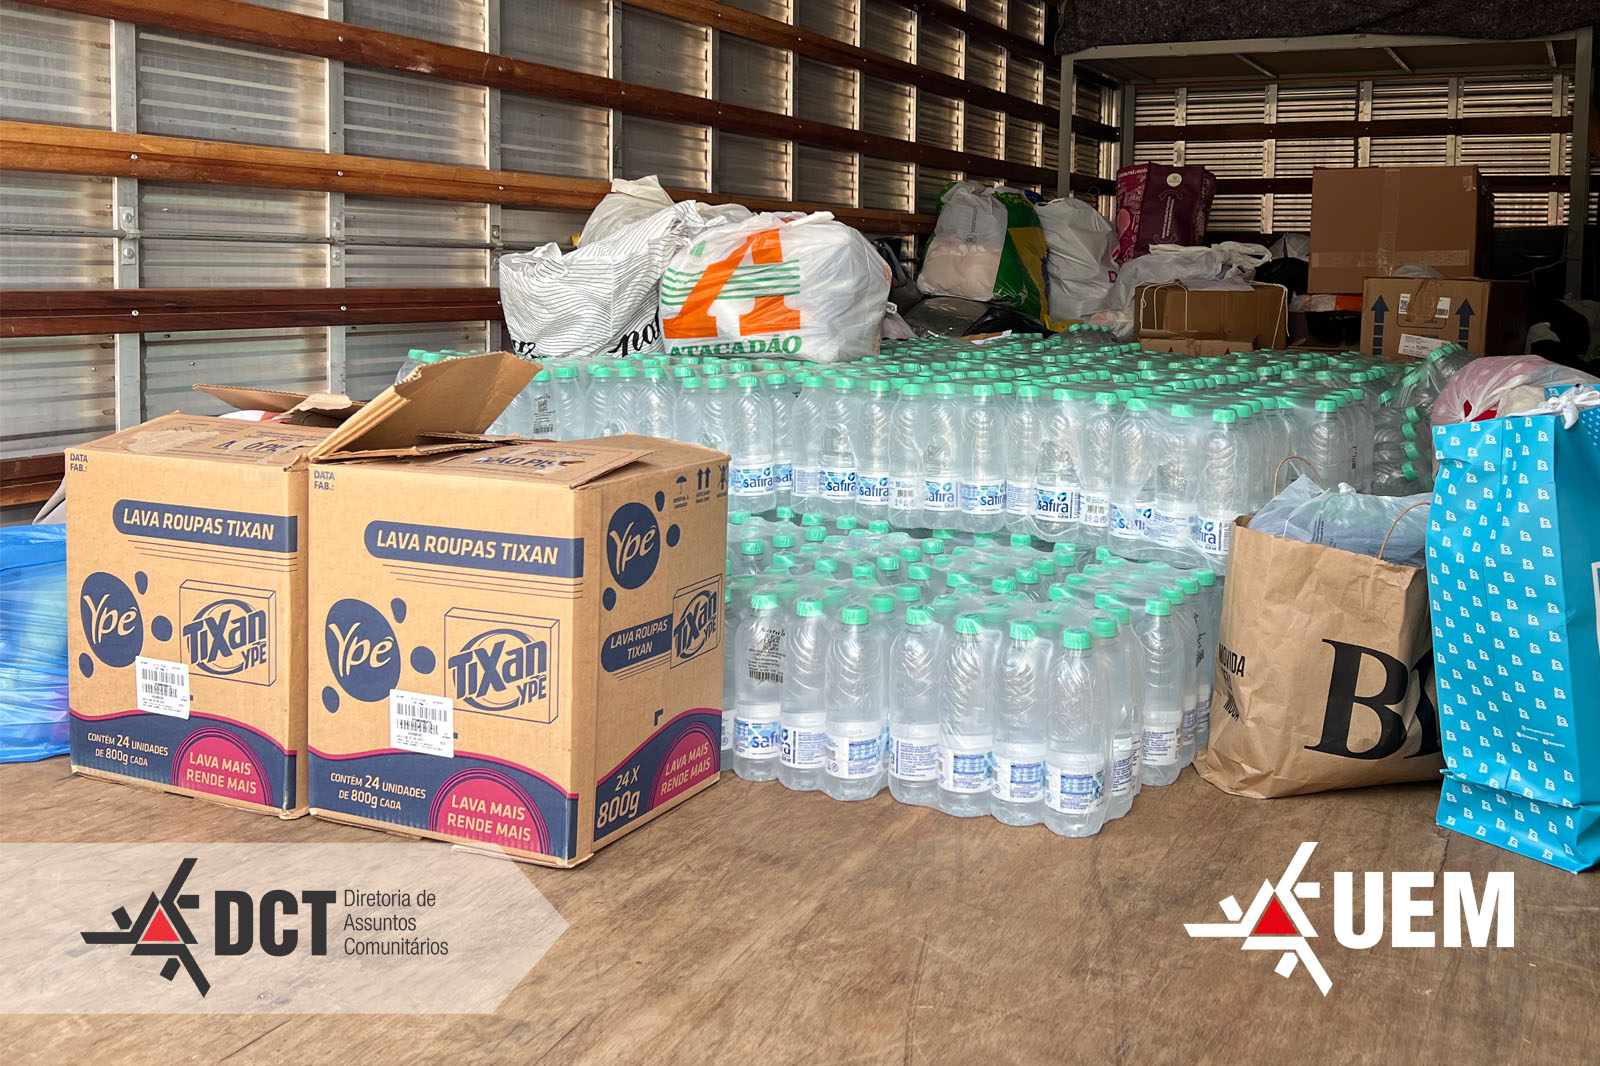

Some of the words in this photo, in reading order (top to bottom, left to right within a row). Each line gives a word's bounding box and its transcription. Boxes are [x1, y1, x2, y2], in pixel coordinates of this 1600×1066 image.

[671, 335, 802, 356] ATACADÃO
[70, 453, 88, 463] DATA
[314, 470, 335, 480] DATA
[743, 474, 773, 489] safira
[859, 485, 889, 497] safira
[928, 489, 954, 503] afira
[1037, 499, 1069, 513] safira
[124, 508, 160, 528] LAVA
[163, 513, 223, 535] ROUPAS
[227, 520, 275, 541] TIXAN
[377, 530, 420, 551] LAVA
[424, 535, 497, 560] ROUPAS
[501, 542, 559, 565] TIXAN
[609, 521, 657, 576] Ypê
[83, 594, 138, 645] Ypê
[610, 631, 634, 649] LAVA
[635, 619, 668, 641] ROUPAS
[328, 622, 395, 678] Ypê
[627, 641, 653, 660] TIXAN
[88, 731, 115, 746] CONTÉM
[116, 734, 130, 749] 24
[131, 741, 169, 756] UNIDADES
[95, 749, 104, 758] DE
[105, 749, 129, 765] 800g
[130, 755, 149, 767] CADA
[189, 752, 219, 769] LAVA
[221, 758, 251, 776] MAIS
[665, 755, 687, 776] LAVA
[688, 741, 709, 762] MAIS
[186, 769, 225, 787] RENDE
[226, 777, 257, 795] MAIS
[330, 772, 363, 788] CONTÉM
[365, 775, 380, 790] 24
[382, 782, 427, 799] UNIDADES
[614, 770, 629, 792] 24
[660, 769, 689, 796] RENDE
[690, 757, 711, 781] MAIS
[338, 790, 350, 801] DE
[351, 789, 378, 809] 800g
[379, 797, 402, 811] CADA
[451, 794, 487, 814] LAVA
[489, 802, 526, 821] MAIS
[596, 790, 641, 829] 800g
[447, 813, 493, 834] RENDE
[495, 822, 532, 842] MAIS
